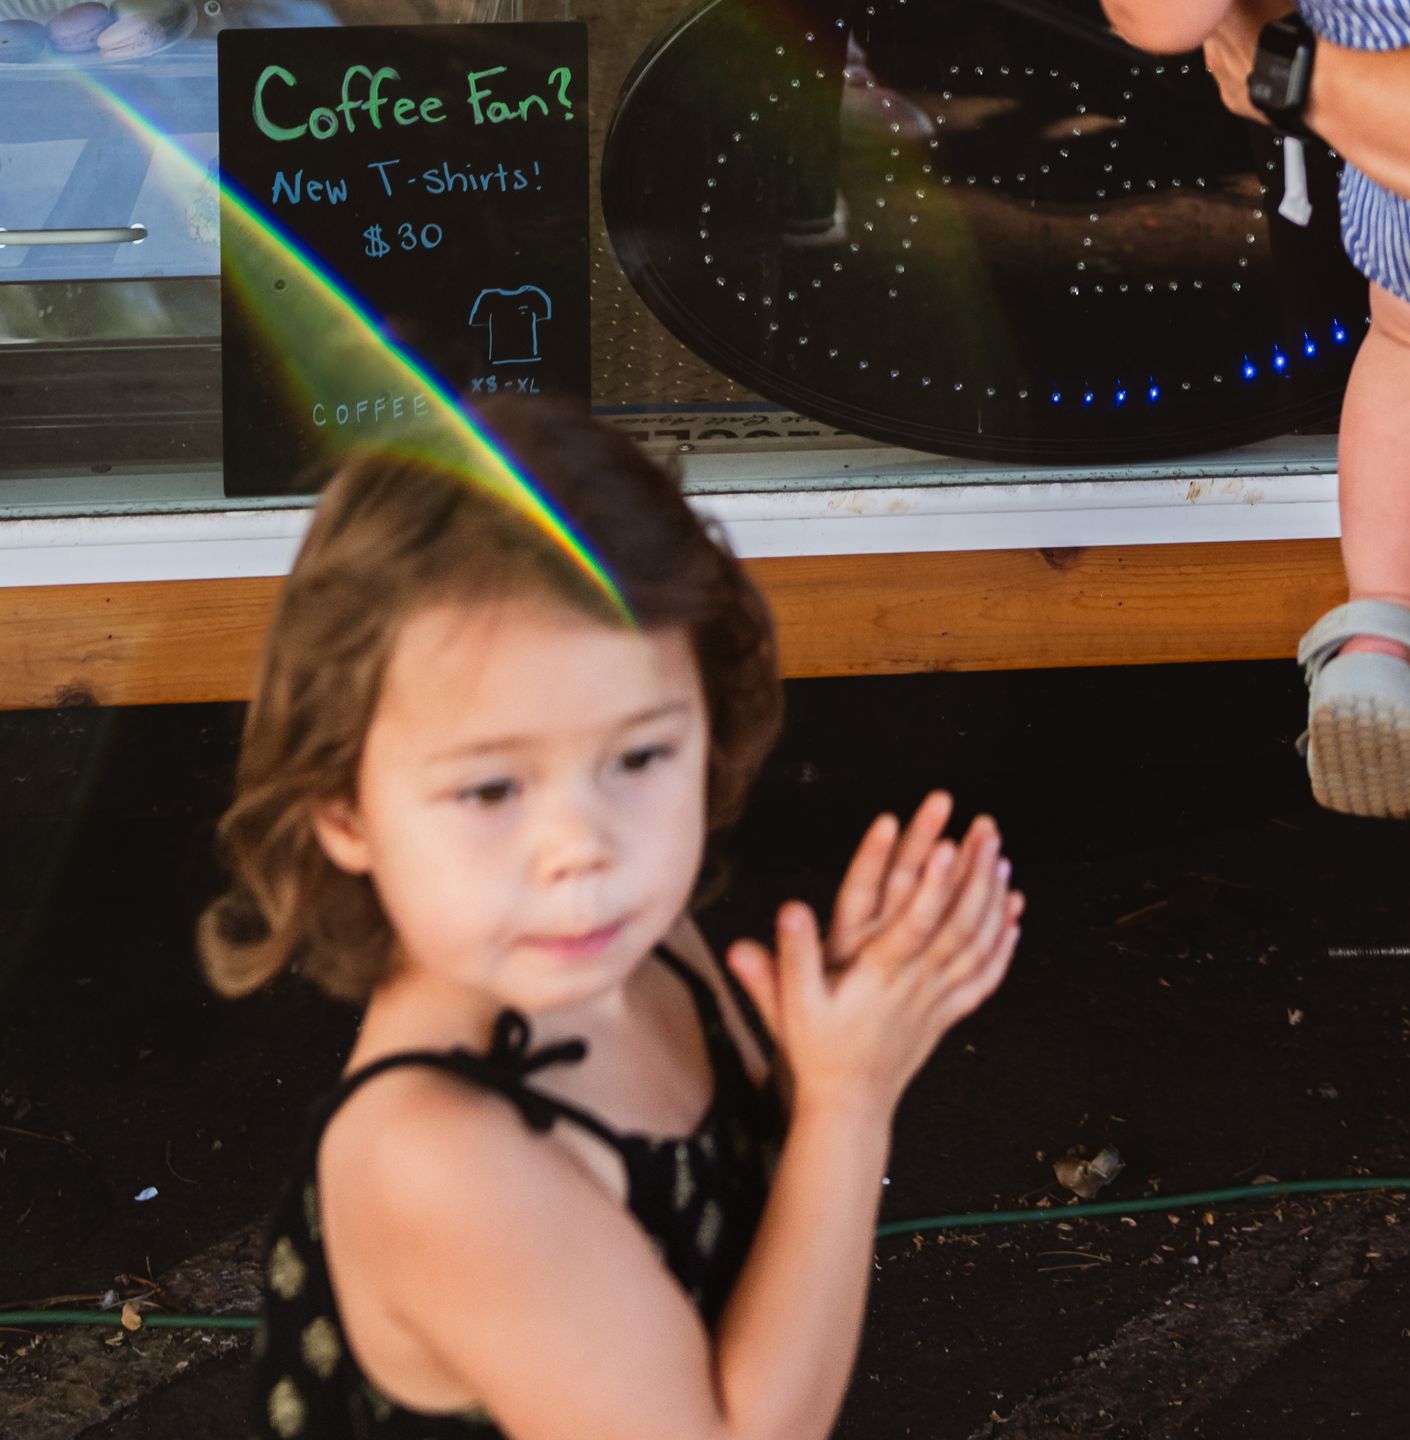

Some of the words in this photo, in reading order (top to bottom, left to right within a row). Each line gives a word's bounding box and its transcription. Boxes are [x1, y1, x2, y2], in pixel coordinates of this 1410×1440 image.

[253, 64, 447, 141] Coffee
[466, 66, 574, 125] Fan?
[271, 168, 348, 205] New
[367, 158, 542, 198] T-shirts!
[312, 393, 430, 426] COFFEE
